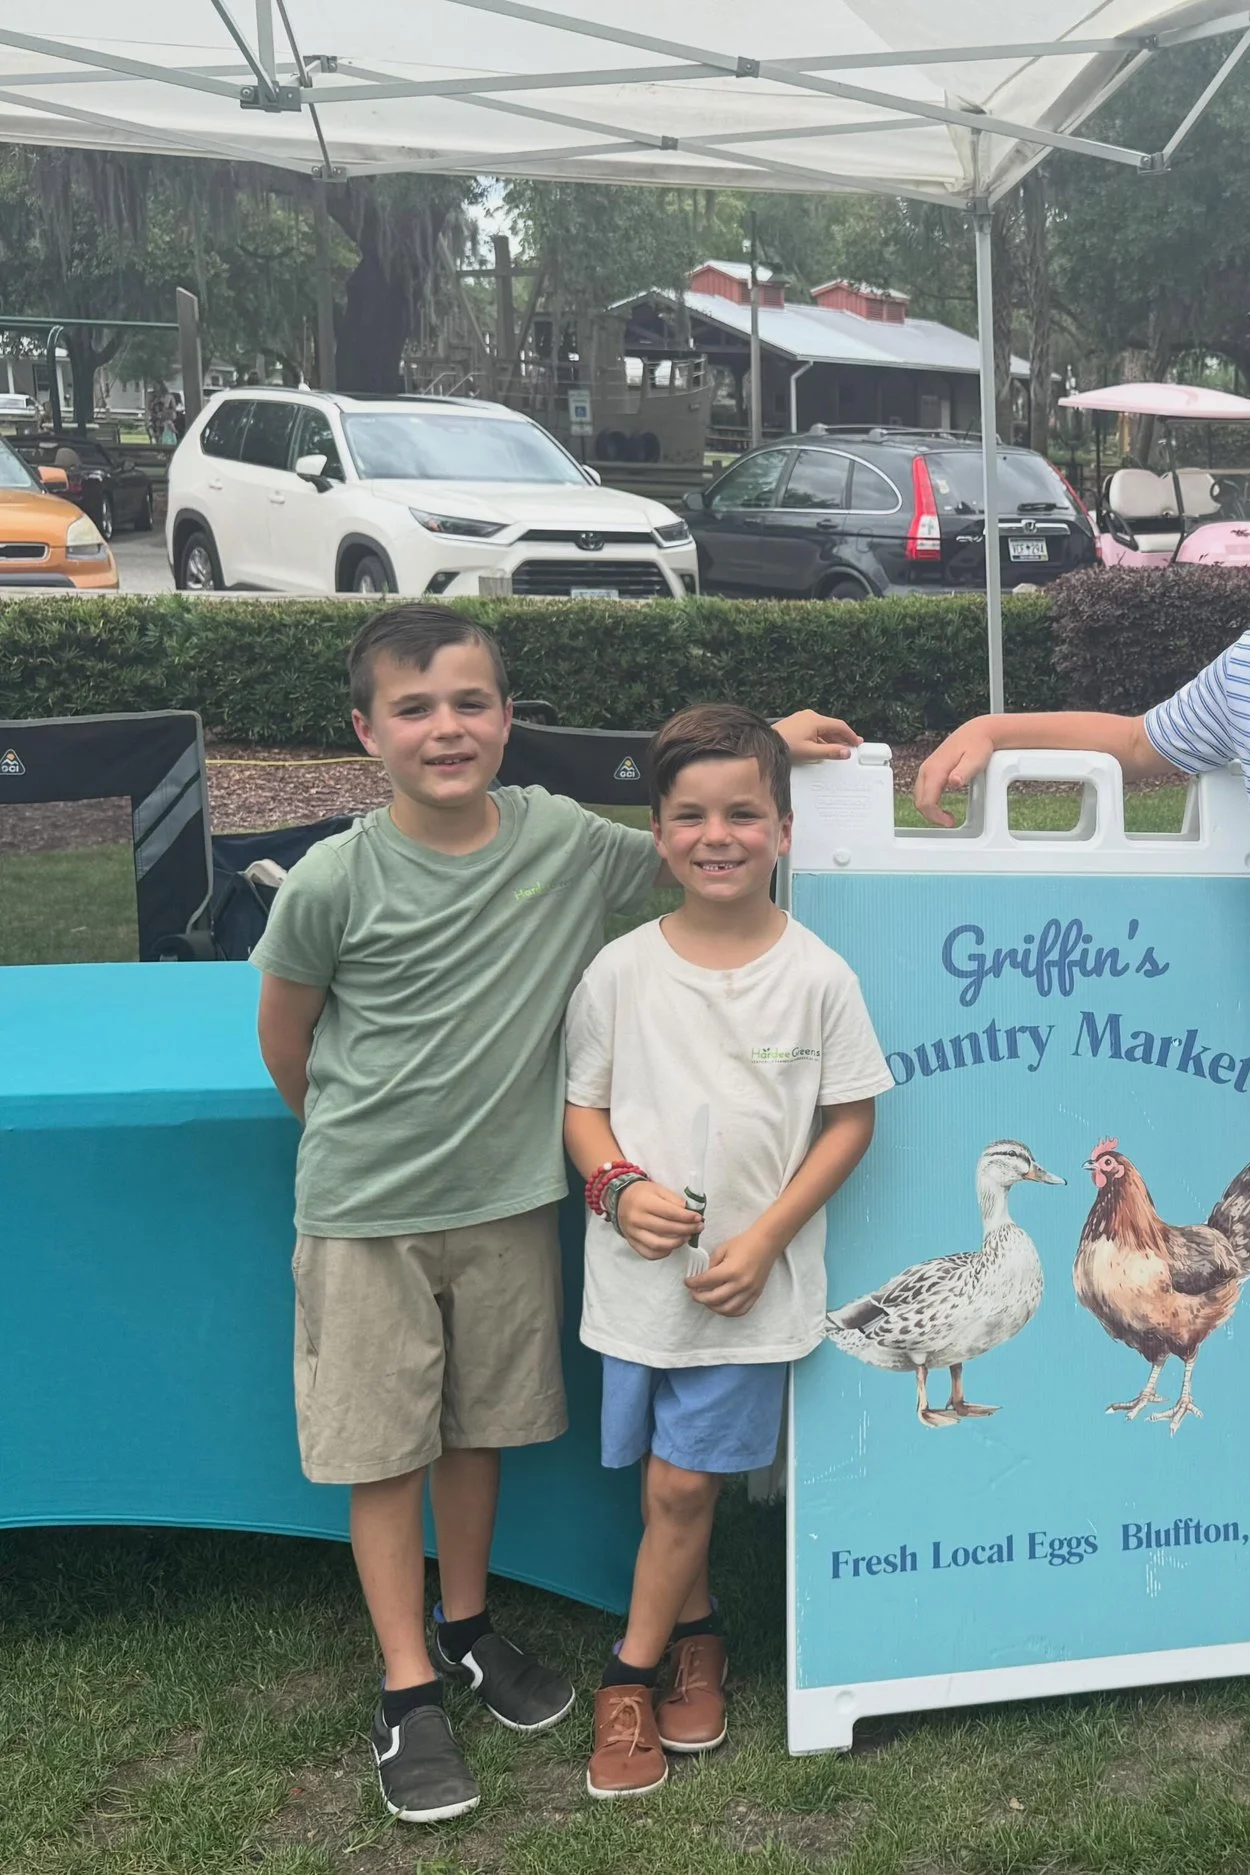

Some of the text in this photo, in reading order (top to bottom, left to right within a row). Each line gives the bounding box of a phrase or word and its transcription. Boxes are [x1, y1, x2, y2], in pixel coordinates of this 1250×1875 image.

[941, 918, 1170, 1007] Griffin's
[751, 1047, 790, 1059] Hardee
[885, 1017, 1056, 1086] ountry
[830, 1544, 919, 1580] Fresh
[931, 1534, 1015, 1570] Local
[1027, 1530, 1099, 1567] Eggs
[1120, 1517, 1250, 1551] Bluffton,
